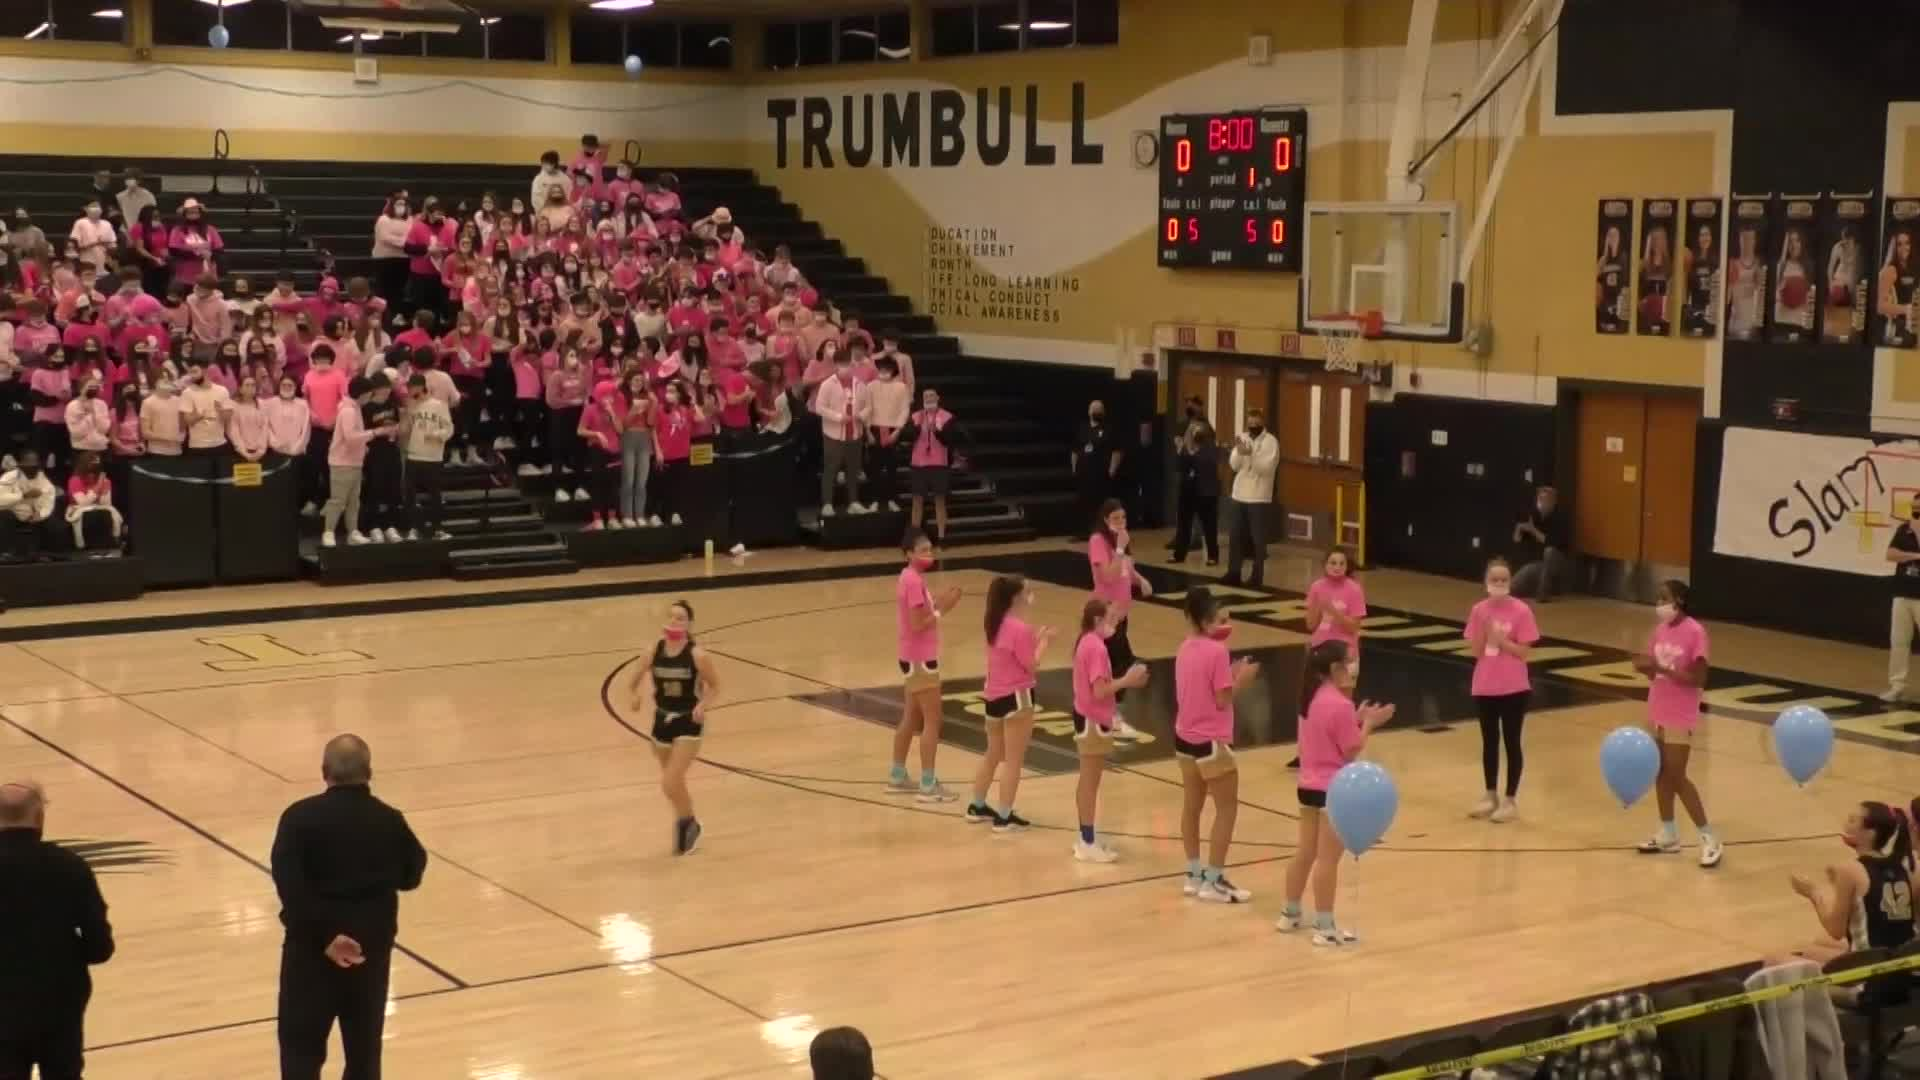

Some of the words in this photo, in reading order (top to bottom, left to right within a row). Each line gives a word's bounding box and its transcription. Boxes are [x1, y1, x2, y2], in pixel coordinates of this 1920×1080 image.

[767, 81, 1104, 169] TRUMBULL
[1208, 119, 1254, 150] 8:00
[1177, 138, 1191, 172] 0
[1275, 136, 1290, 171] 0
[1249, 167, 1255, 188] 1
[1167, 217, 1179, 242] 0
[1188, 218, 1199, 241] 5
[1247, 219, 1257, 243] 5
[1272, 219, 1284, 244] 0
[1008, 274, 1080, 292] LEARNING
[988, 290, 1051, 307] CONDUCT
[981, 306, 1062, 323] AWARENESS
[1768, 455, 1885, 559] Slam
[1879, 881, 1912, 921] 42
